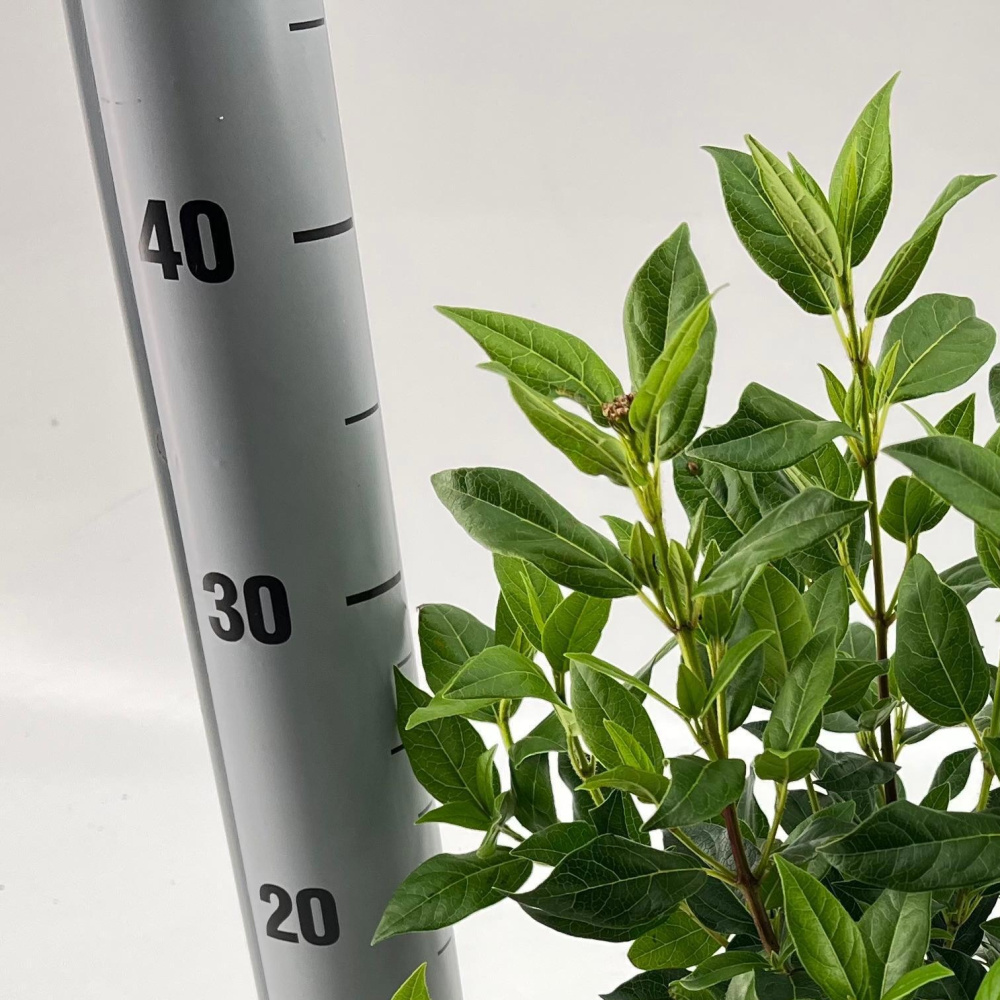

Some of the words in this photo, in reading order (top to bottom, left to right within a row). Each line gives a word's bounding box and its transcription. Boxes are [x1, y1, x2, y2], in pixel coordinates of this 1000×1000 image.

[140, 199, 235, 284] 40
[203, 572, 293, 646] 30
[259, 883, 340, 947] 20
